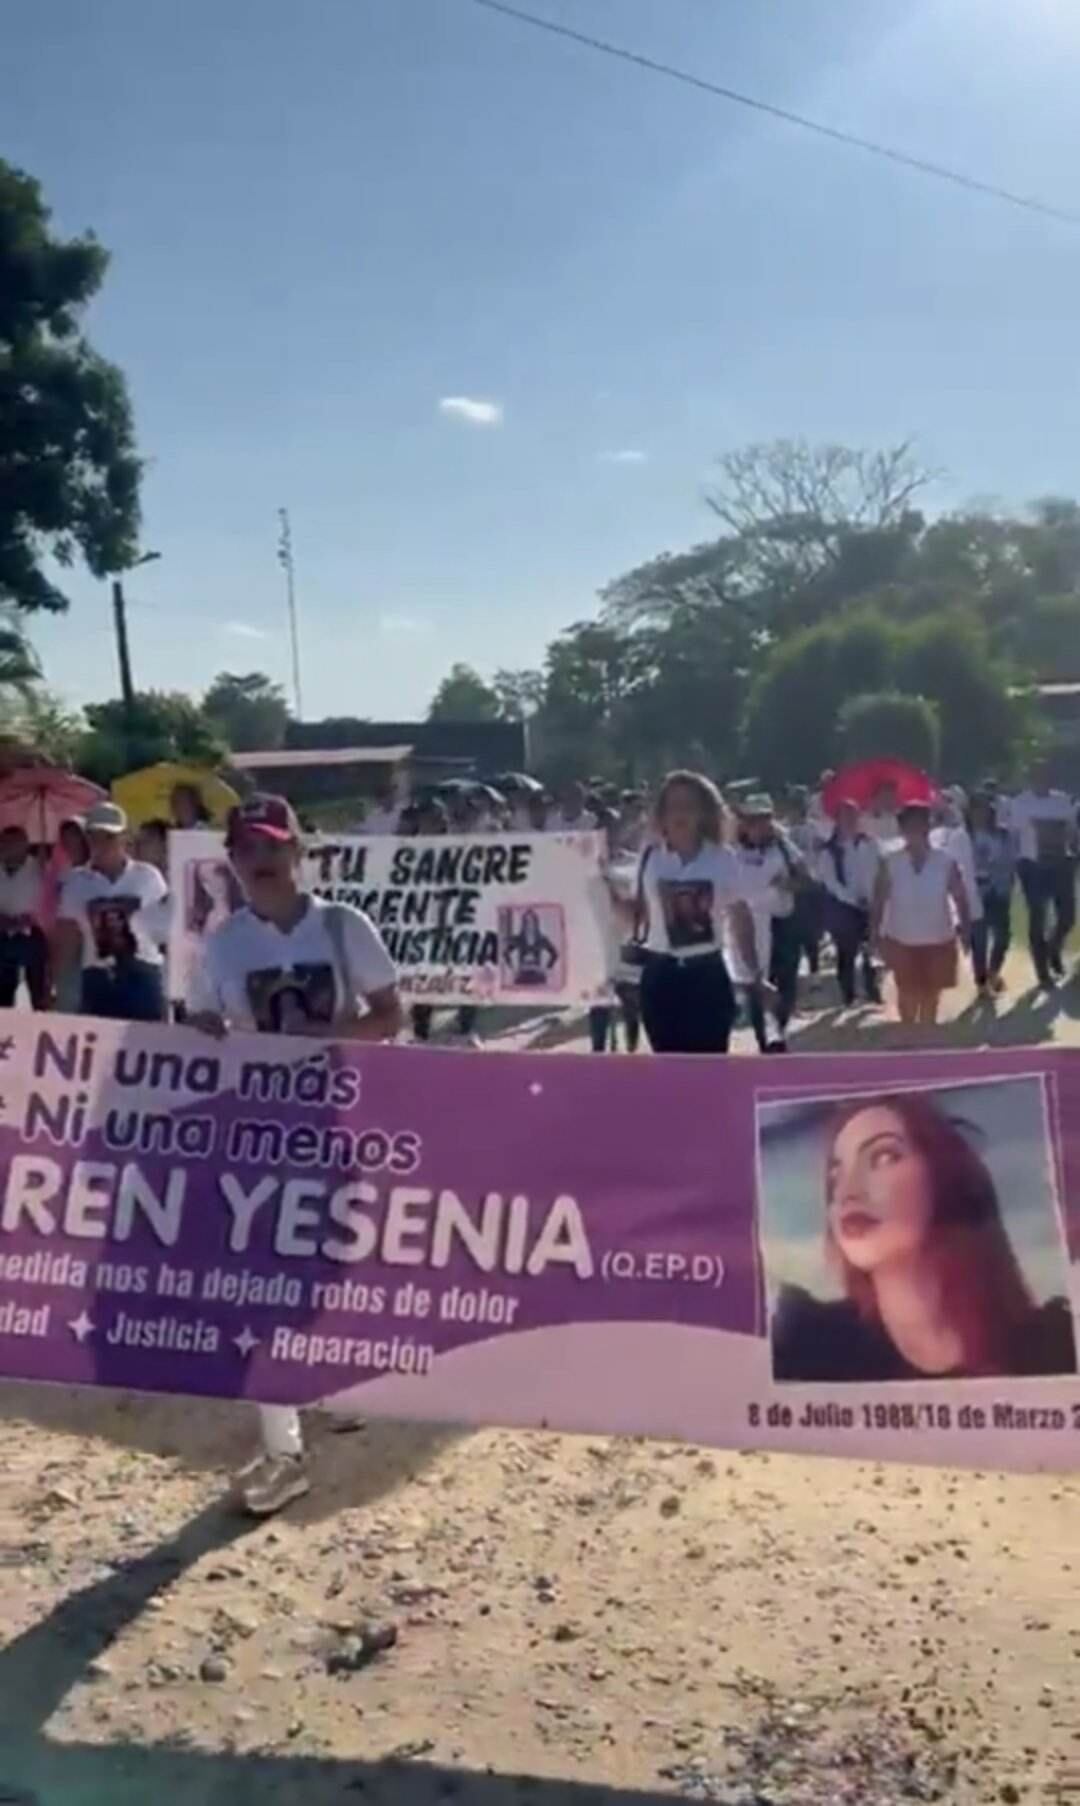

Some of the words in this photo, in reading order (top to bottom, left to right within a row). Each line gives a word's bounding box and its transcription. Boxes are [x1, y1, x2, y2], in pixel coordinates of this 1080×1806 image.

[308, 847, 367, 882] TU
[390, 845, 532, 885] SANGRE
[33, 1030, 98, 1081] Ni
[114, 1049, 220, 1093] una
[239, 1055, 361, 1109] más
[23, 1091, 89, 1146] Ni
[104, 1108, 214, 1155] una
[228, 1117, 421, 1174] menos
[2, 1155, 187, 1246] REN
[220, 1172, 594, 1280] YESENIA
[96, 1262, 148, 1293] nos
[157, 1262, 194, 1298] ha
[202, 1267, 302, 1306] dejado
[311, 1280, 386, 1314] rotos
[393, 1283, 431, 1318] de
[440, 1287, 519, 1325] dolor
[106, 1311, 219, 1354] Justicia
[271, 1326, 435, 1375] Reparación
[767, 1403, 792, 1428] de
[799, 1402, 853, 1428] Julio
[958, 1405, 985, 1429] de
[993, 1403, 1066, 1430] Marzo
